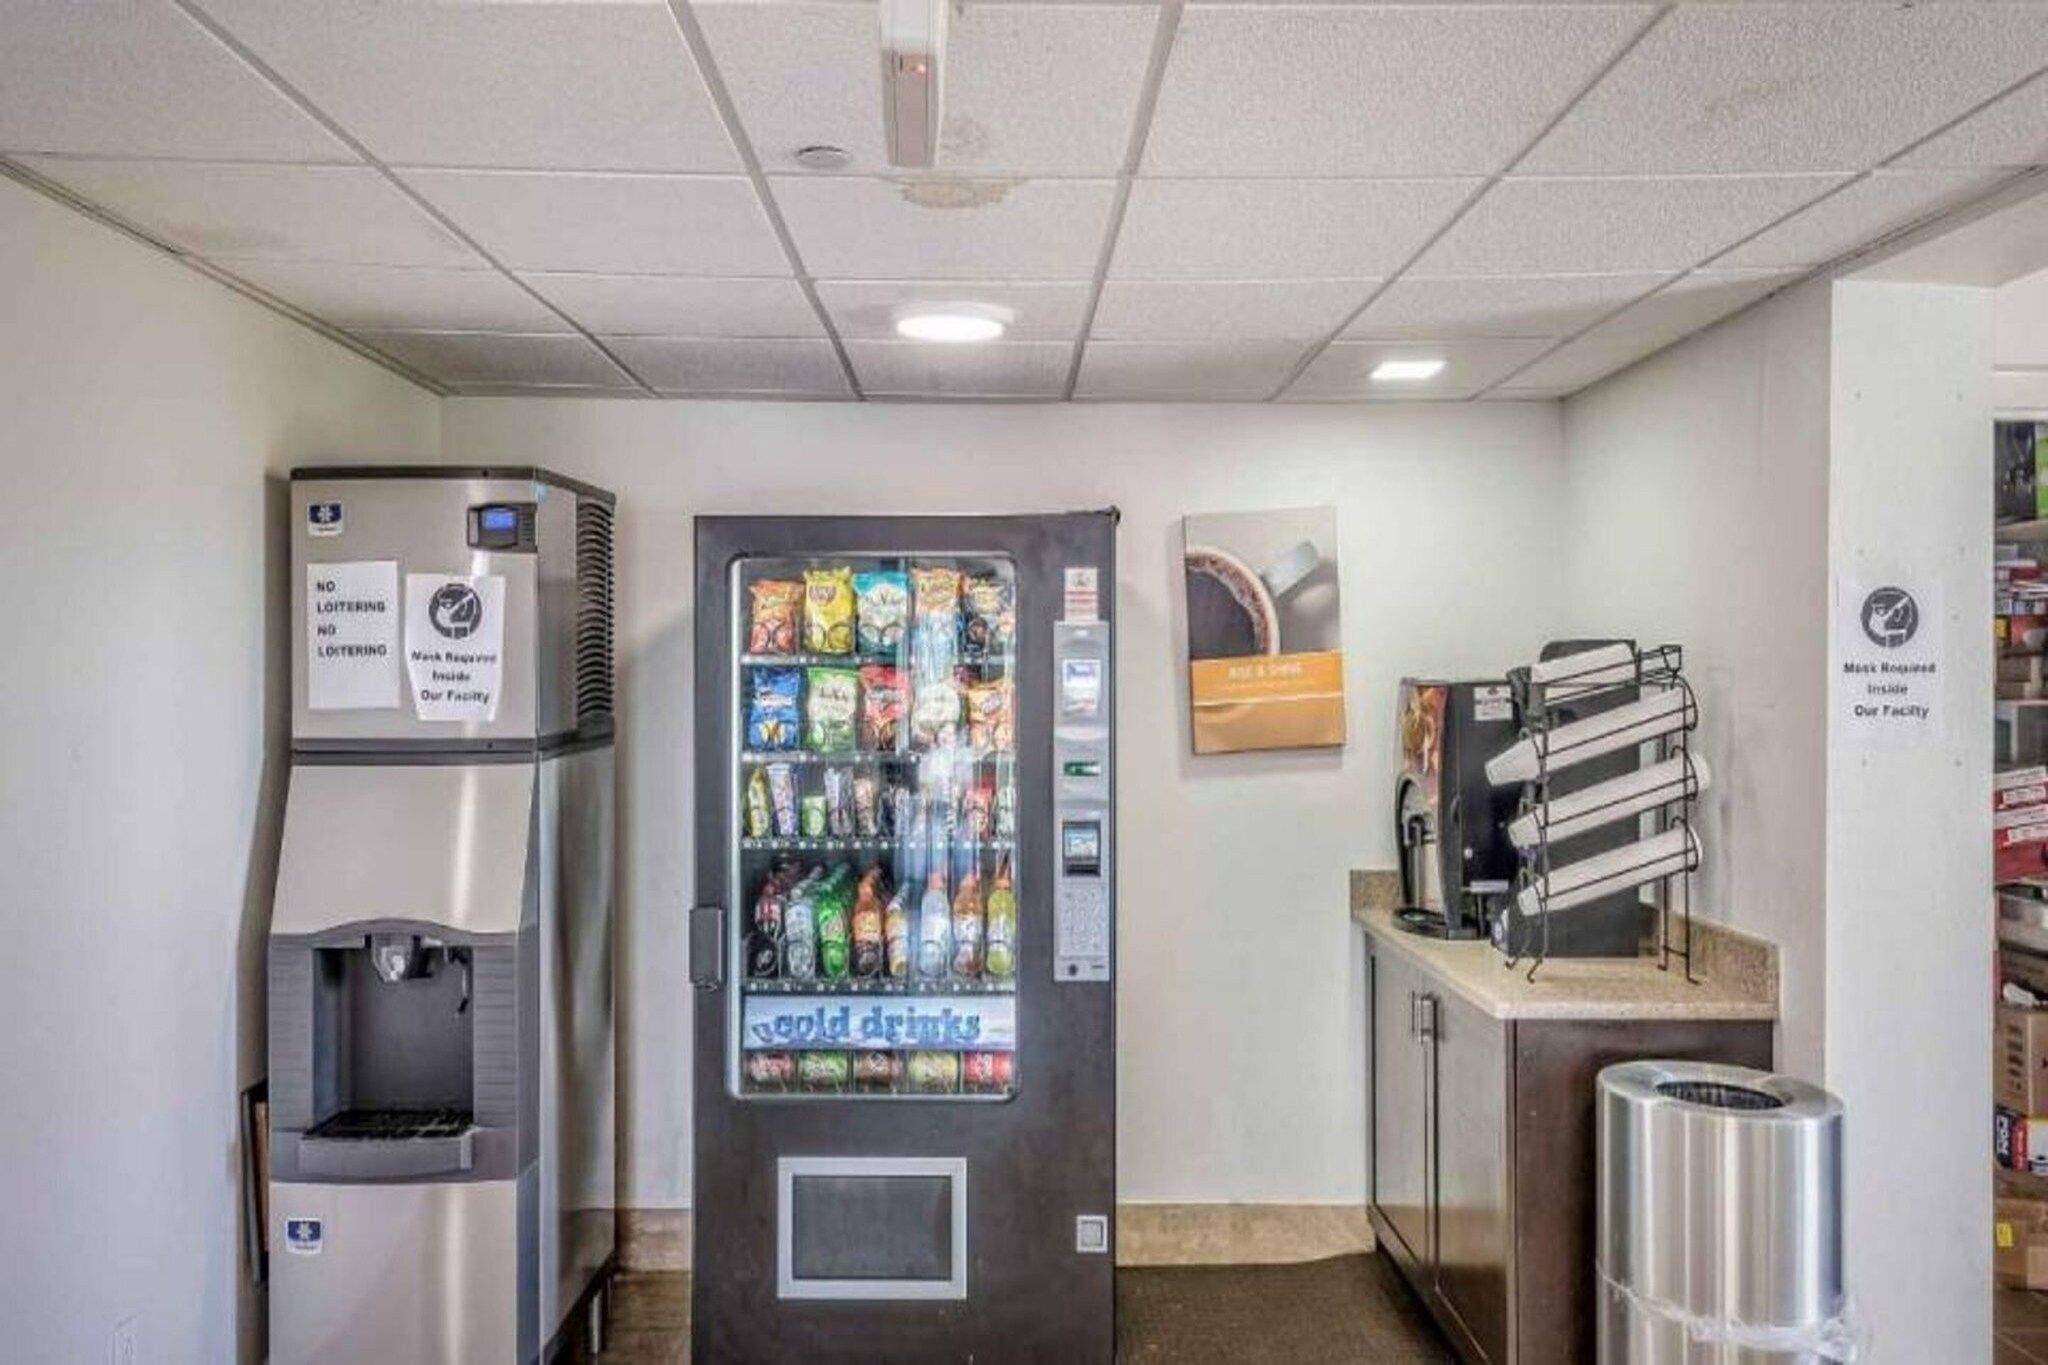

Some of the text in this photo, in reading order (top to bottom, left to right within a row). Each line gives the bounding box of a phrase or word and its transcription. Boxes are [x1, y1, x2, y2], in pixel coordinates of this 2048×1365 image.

[316, 580, 336, 593] NO
[317, 600, 386, 614] LOITERING
[317, 623, 336, 637] NO
[318, 643, 388, 658] LOITERING
[411, 649, 497, 665] Mask Required
[432, 669, 471, 681] Inside
[1843, 661, 1936, 676] Mask Required
[421, 689, 443, 701] Our
[1867, 683, 1909, 696] Inside
[1853, 703, 1879, 718] Our
[774, 1004, 982, 1044] cold drinks
